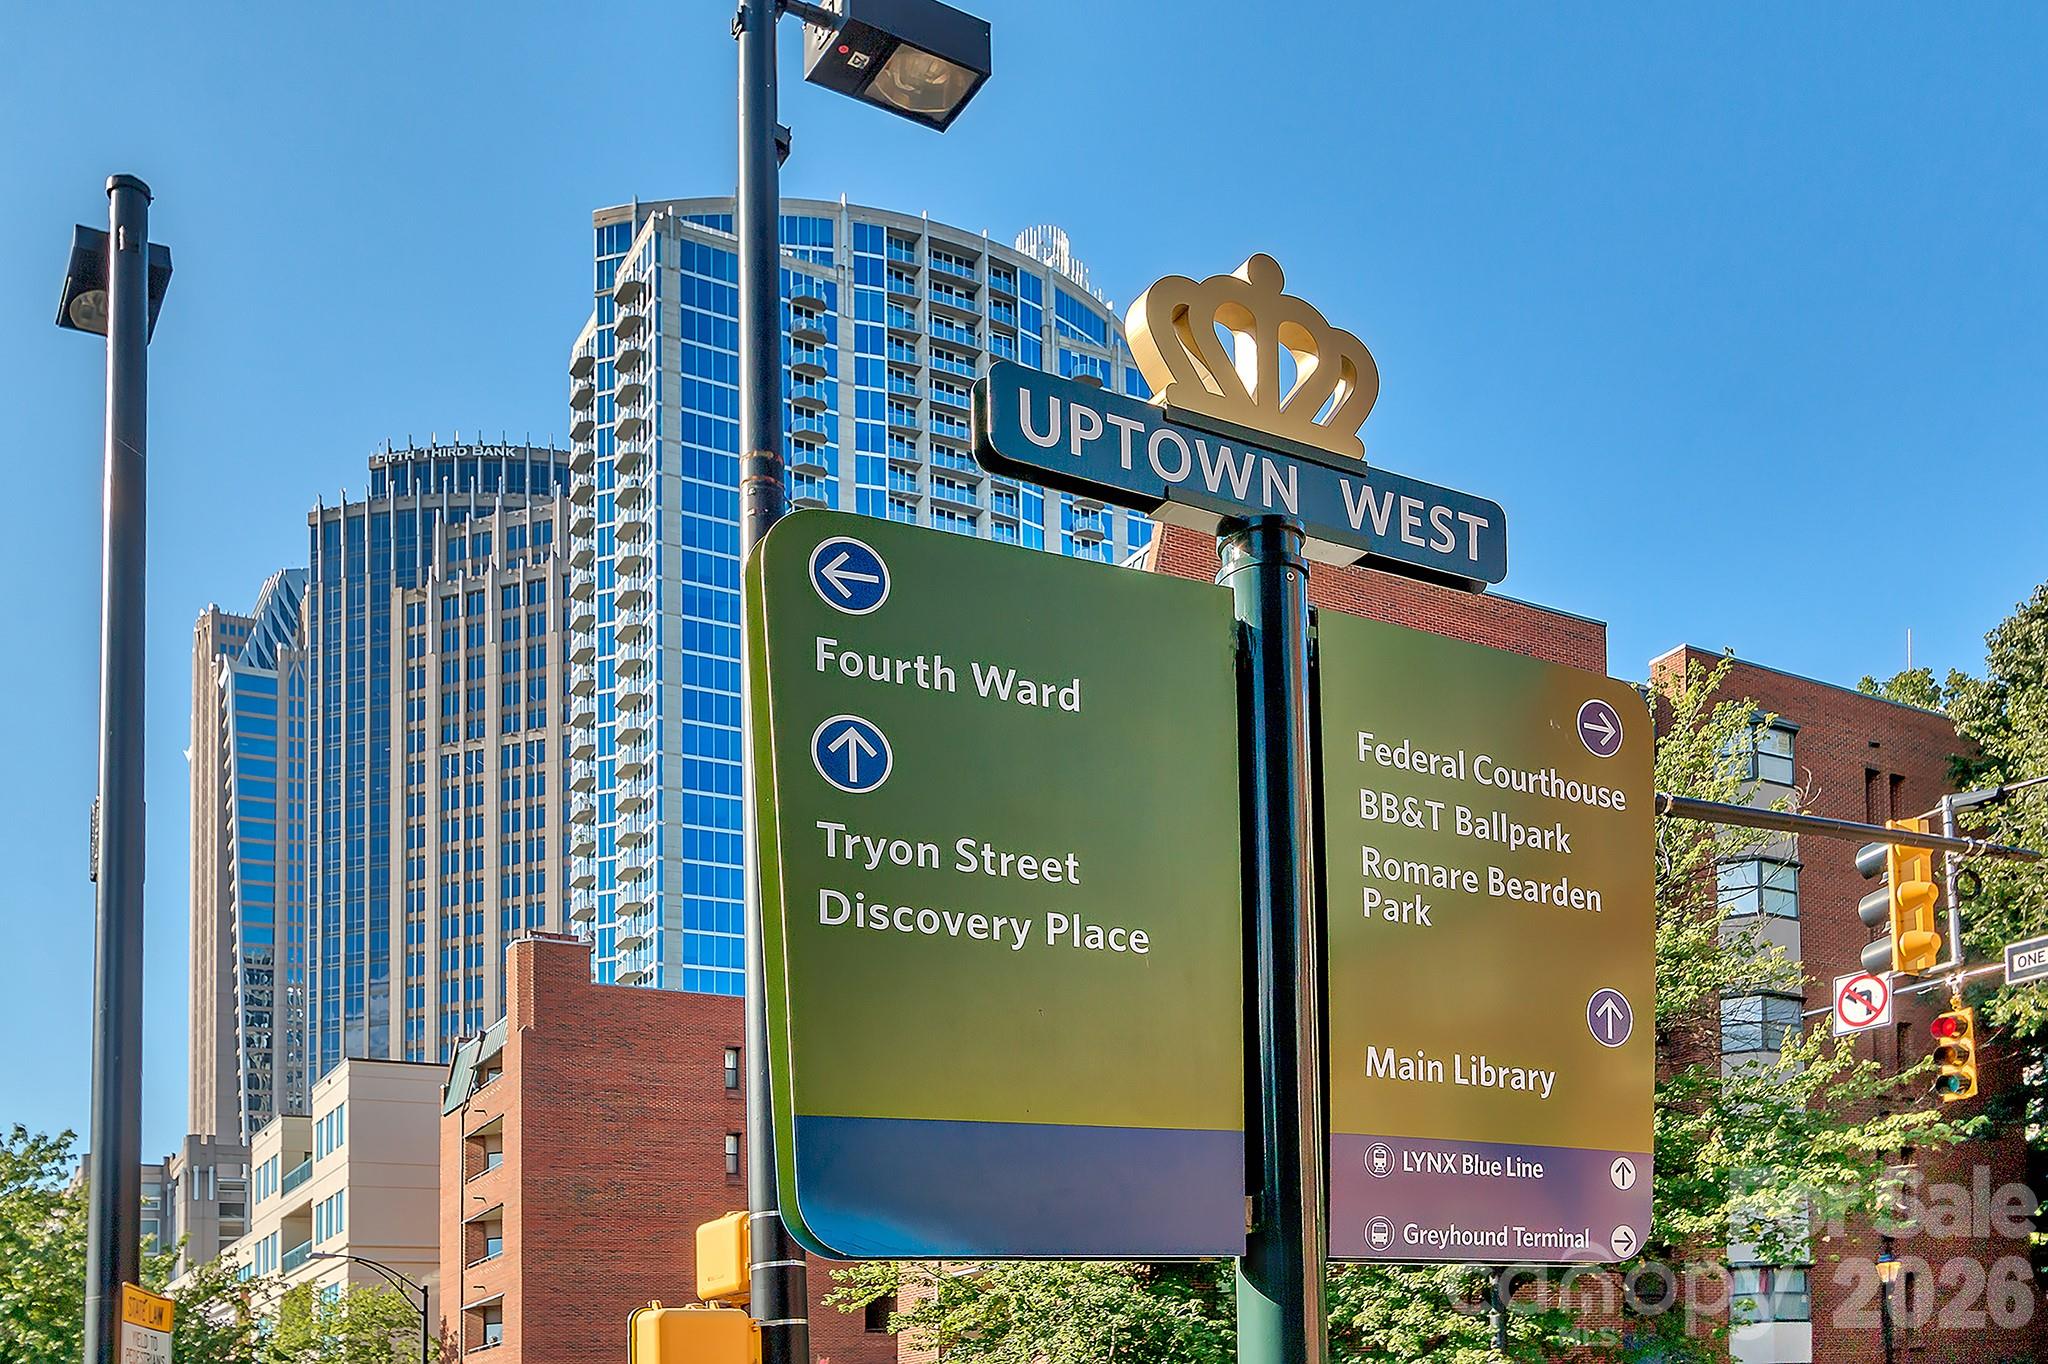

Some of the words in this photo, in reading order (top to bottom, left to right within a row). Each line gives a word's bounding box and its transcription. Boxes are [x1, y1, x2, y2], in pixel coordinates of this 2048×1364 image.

[375, 450, 415, 464] FIFTH
[422, 447, 468, 458] THIRD
[472, 446, 516, 457] BANK
[1018, 387, 1299, 514] UPTOWN
[1339, 478, 1489, 561] WEST
[815, 636, 956, 693] Fourth
[970, 662, 1081, 712] Ward
[1357, 731, 1466, 780] Federal
[1473, 754, 1627, 811] Courthouse
[816, 821, 940, 870] Tryon
[955, 837, 1080, 885] Street
[1359, 788, 1445, 831] BB&T
[1456, 805, 1572, 854] Ballpark
[1361, 845, 1479, 894] Romare
[1488, 866, 1602, 912] Bearden
[1362, 887, 1433, 927] Park
[818, 888, 1032, 951] Discovery
[1046, 912, 1151, 954] Place
[2017, 950, 2046, 968] ONE
[1365, 1045, 1444, 1083] Main
[1454, 1054, 1557, 1099] Library
[1402, 1150, 1457, 1174] LYNX
[1462, 1153, 1502, 1177] Blue
[1506, 1156, 1545, 1179] Line
[1403, 1222, 1509, 1250] Greyhound
[1512, 1226, 1590, 1249] Terminal
